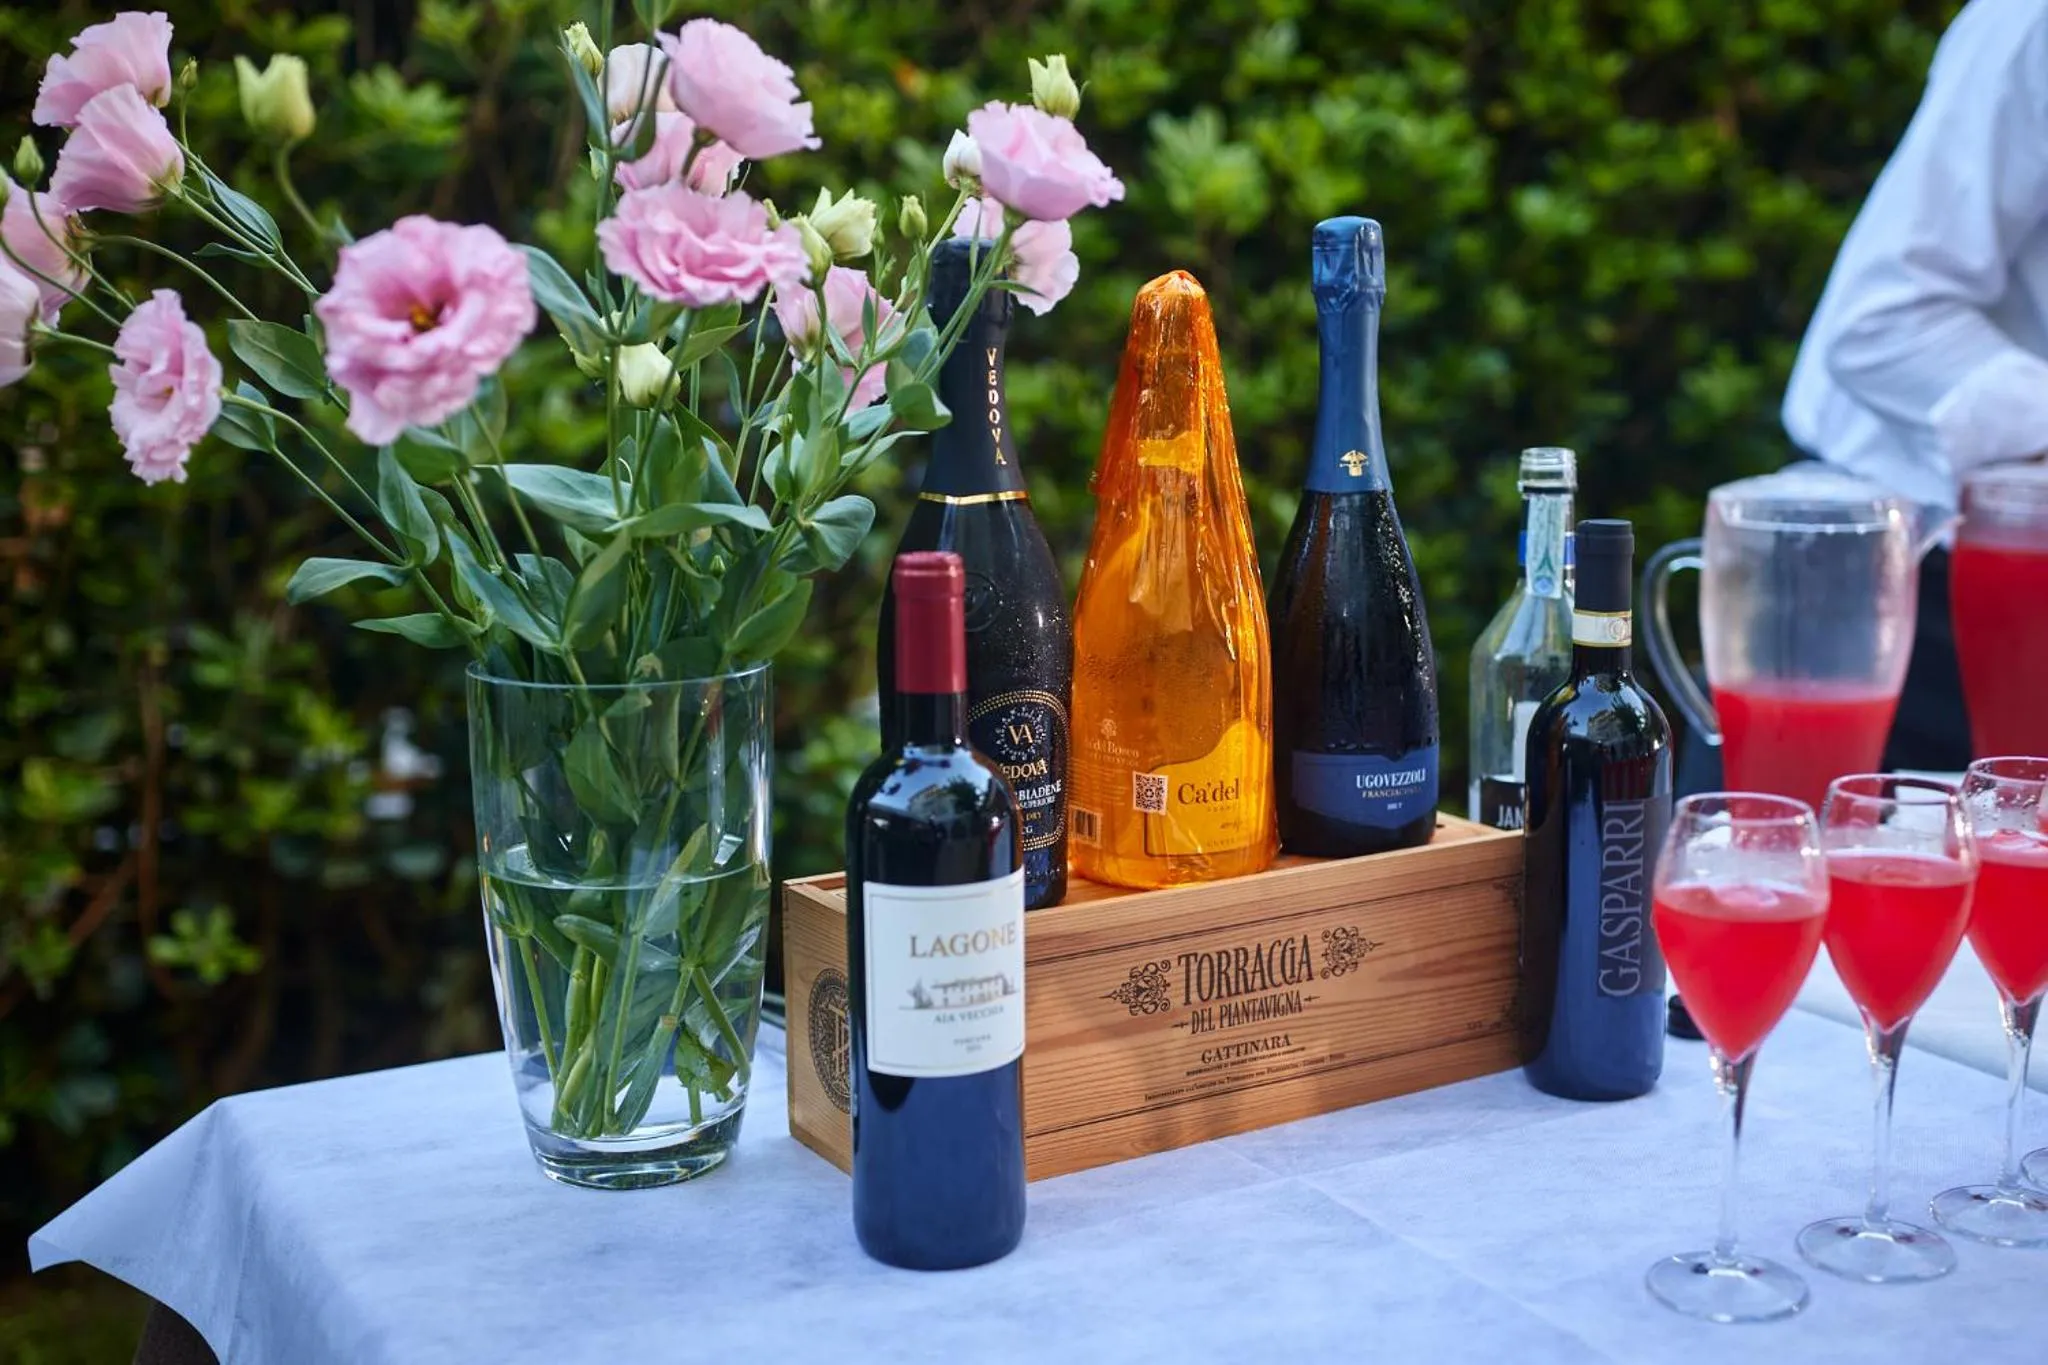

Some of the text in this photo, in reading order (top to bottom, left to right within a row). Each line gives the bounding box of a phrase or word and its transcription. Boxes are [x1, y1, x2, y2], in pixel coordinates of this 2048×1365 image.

[986, 348, 1007, 465] VEDOVA
[1008, 724, 1034, 745] VA
[1000, 758, 1048, 779] EDOVA
[1356, 768, 1426, 789] UGOVEZZOLI
[1015, 779, 1062, 801] BIADENE
[1598, 801, 1645, 997] GASPARRI
[909, 920, 1016, 959] LAGONE
[1191, 990, 1303, 1034] DEL PIANTAVIGNA
[1201, 1033, 1292, 1064] GATTINARA
